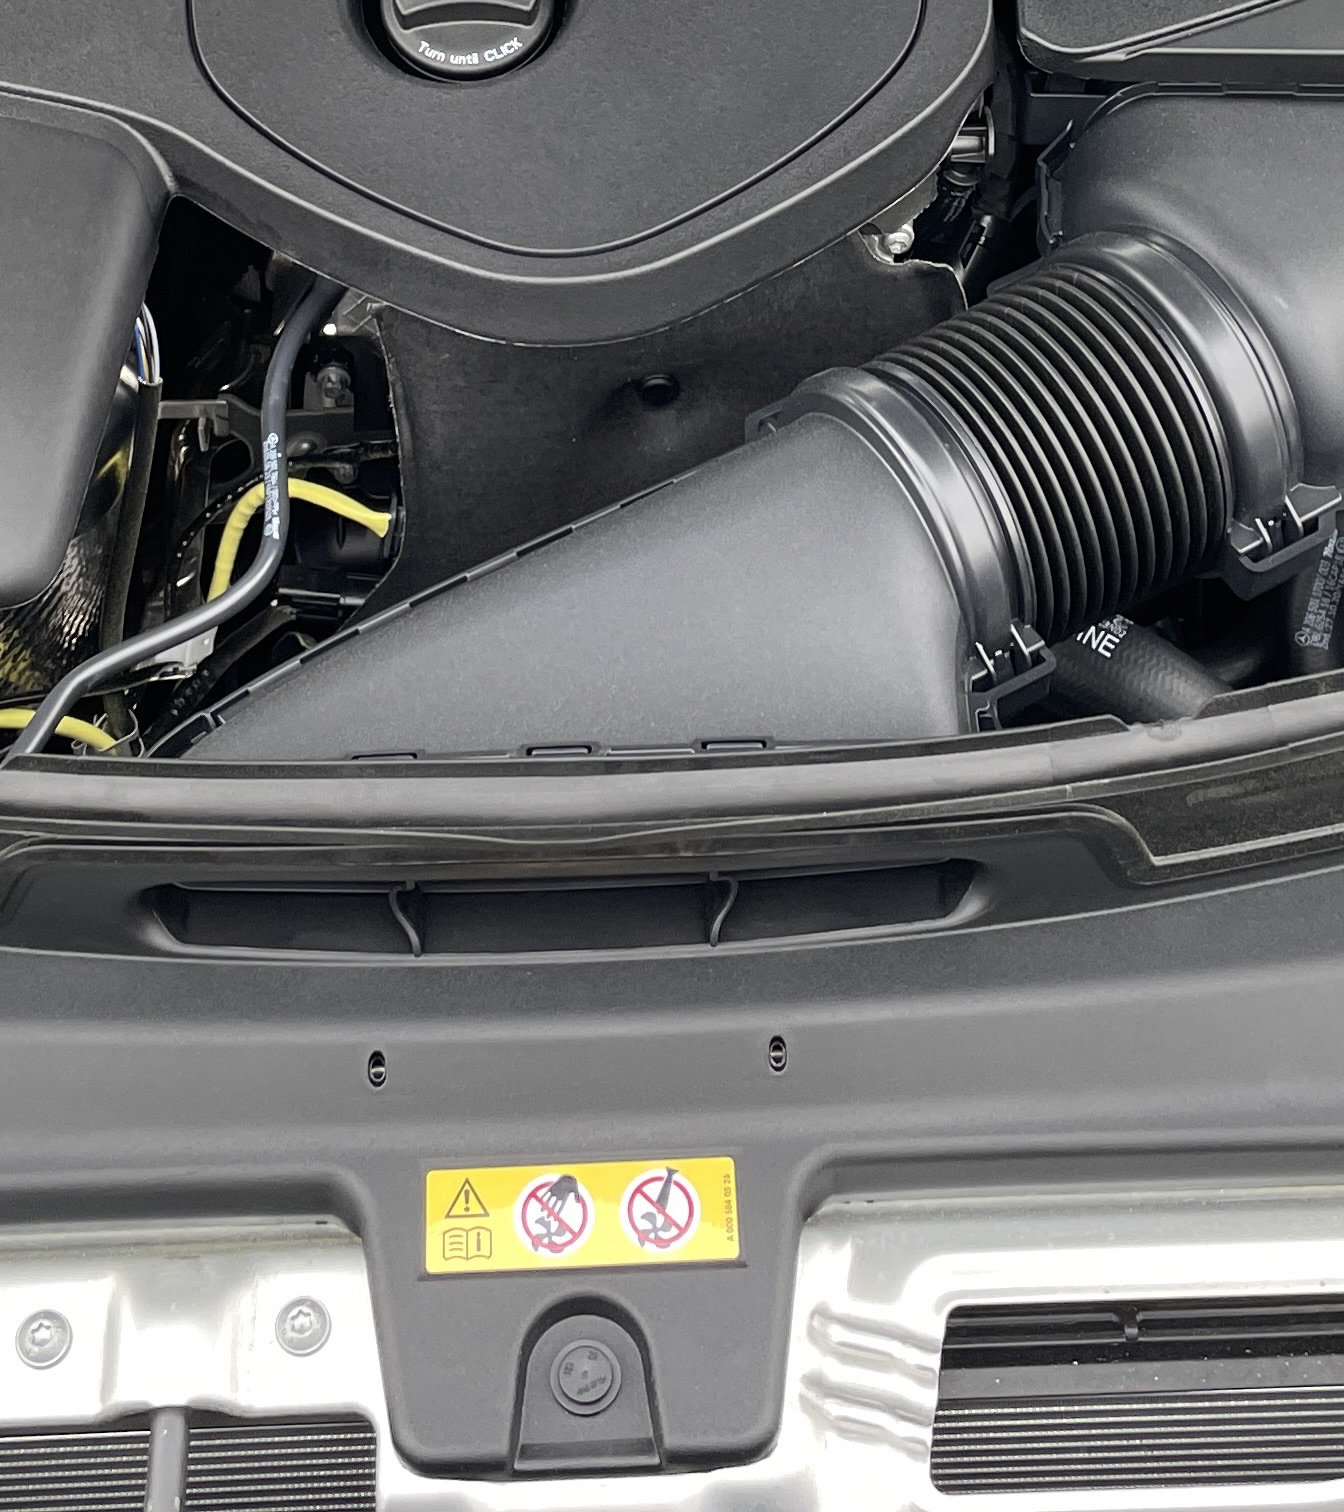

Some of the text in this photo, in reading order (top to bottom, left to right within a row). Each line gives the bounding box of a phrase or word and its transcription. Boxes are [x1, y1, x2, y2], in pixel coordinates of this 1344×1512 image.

[417, 37, 524, 66] Turn until CLICK
[724, 1217, 734, 1234] 000
[726, 1234, 736, 1242] A
